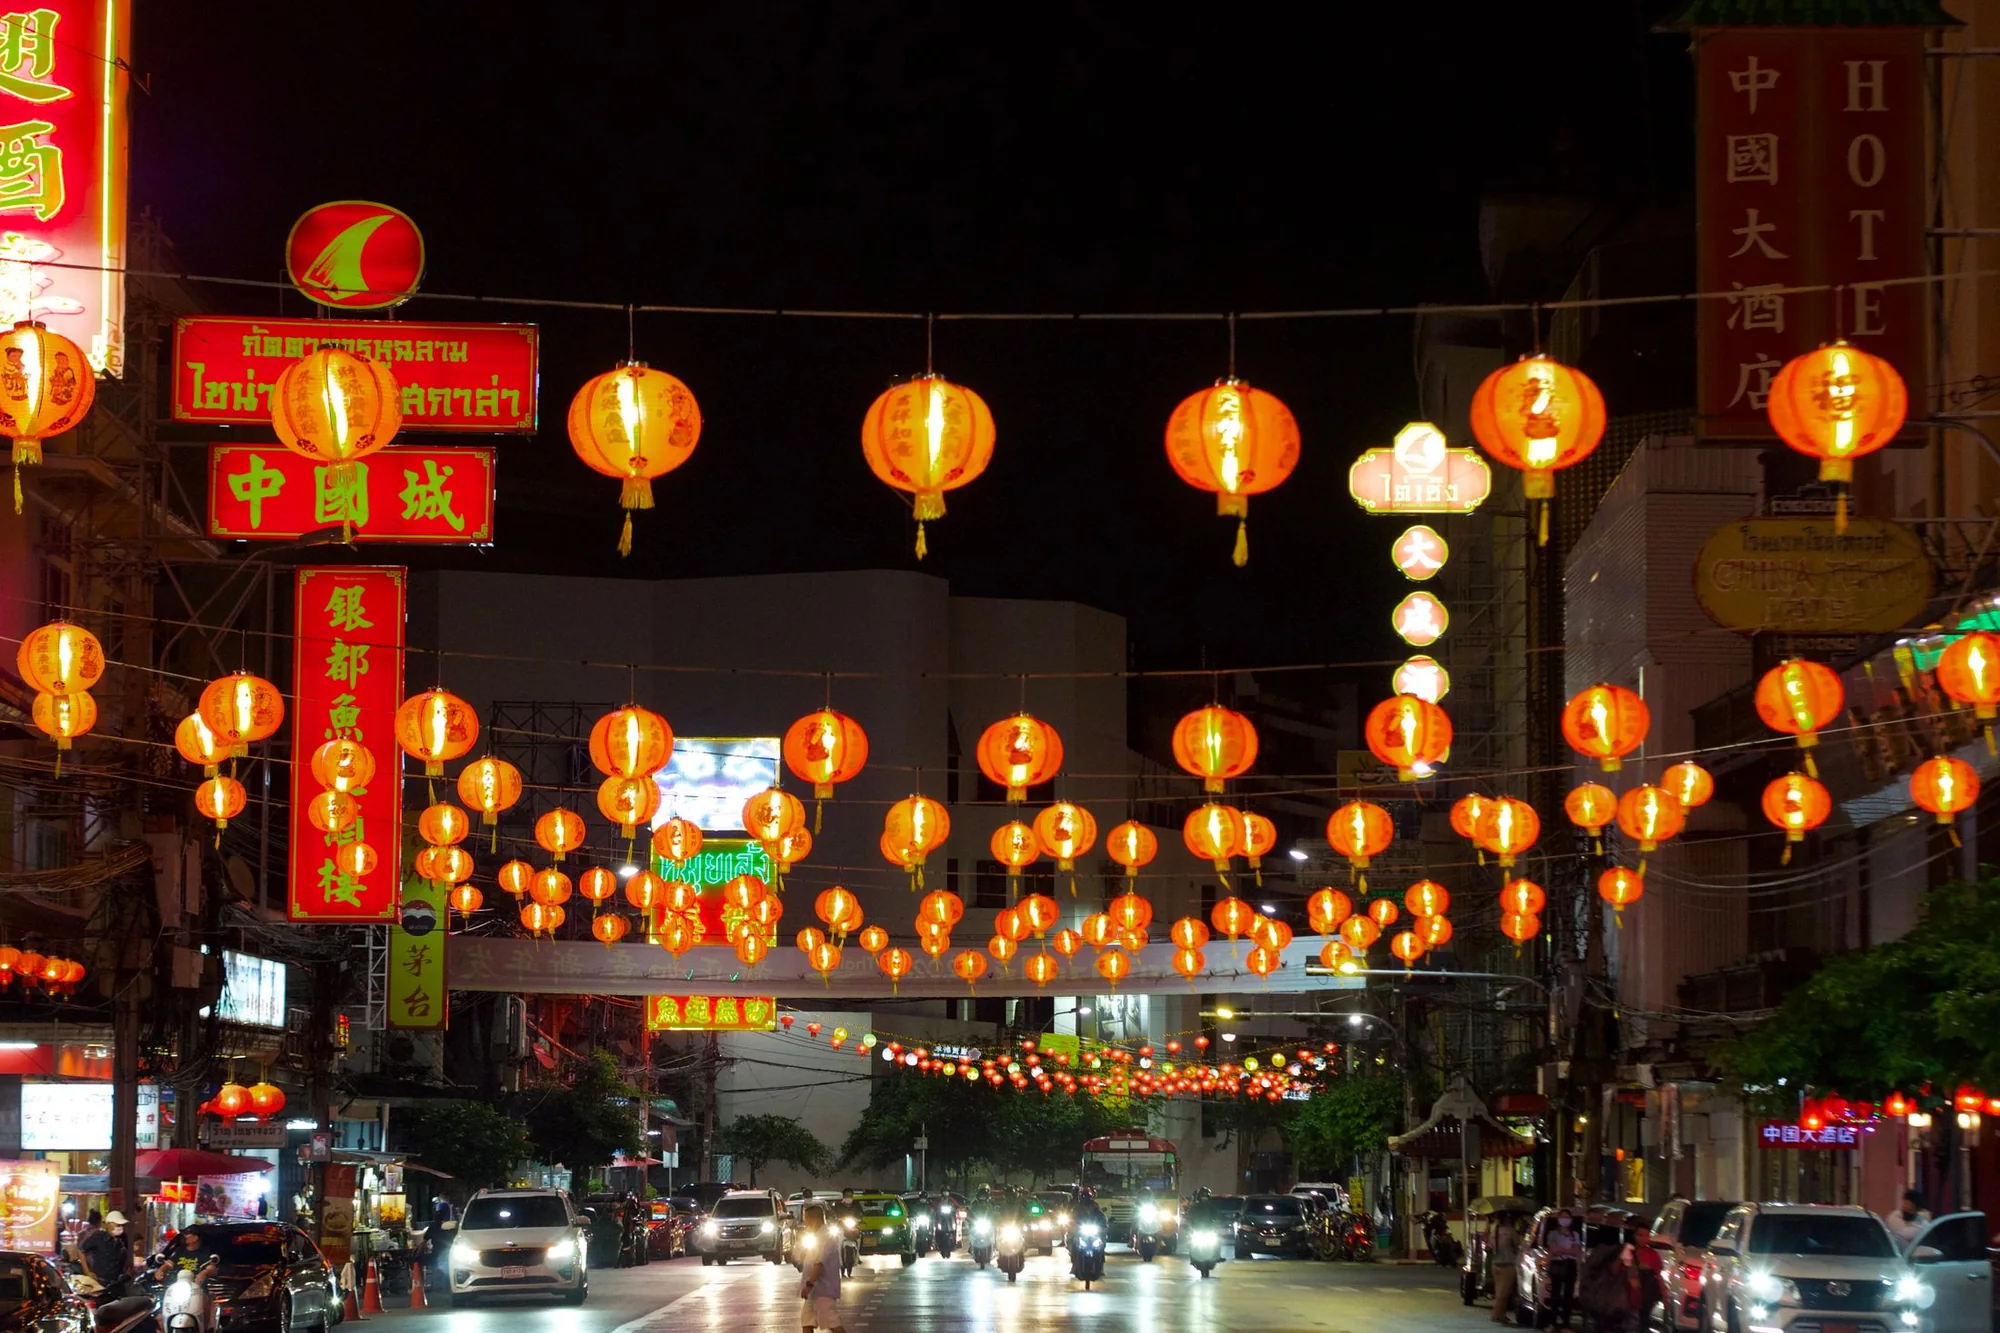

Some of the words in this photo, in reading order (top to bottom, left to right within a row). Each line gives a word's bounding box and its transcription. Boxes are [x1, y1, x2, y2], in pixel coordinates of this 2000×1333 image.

[1725, 54, 1790, 410] 中國大酒店
[1841, 59, 1890, 336] HOTE
[228, 453, 466, 532] 中國城
[1712, 558, 1816, 592] CHINA
[402, 944, 433, 1018] 茅台
[1763, 1124, 1855, 1144] 中国大酒店
